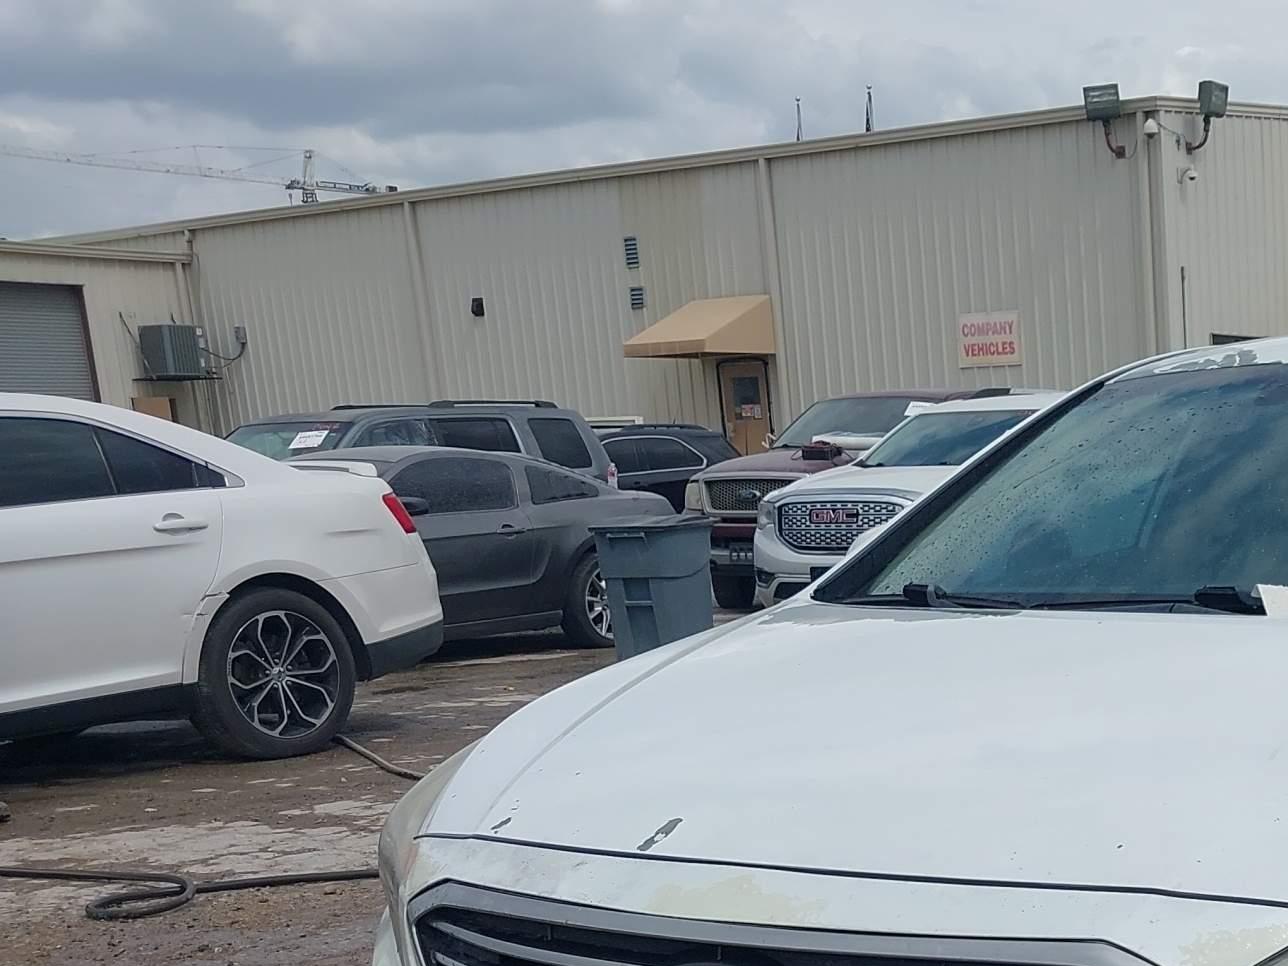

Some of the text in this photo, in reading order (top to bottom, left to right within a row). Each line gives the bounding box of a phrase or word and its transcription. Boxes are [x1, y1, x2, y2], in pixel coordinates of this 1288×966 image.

[961, 320, 1014, 338] COMPANY
[963, 341, 1016, 358] VEHICLES
[810, 509, 858, 523] GMC
